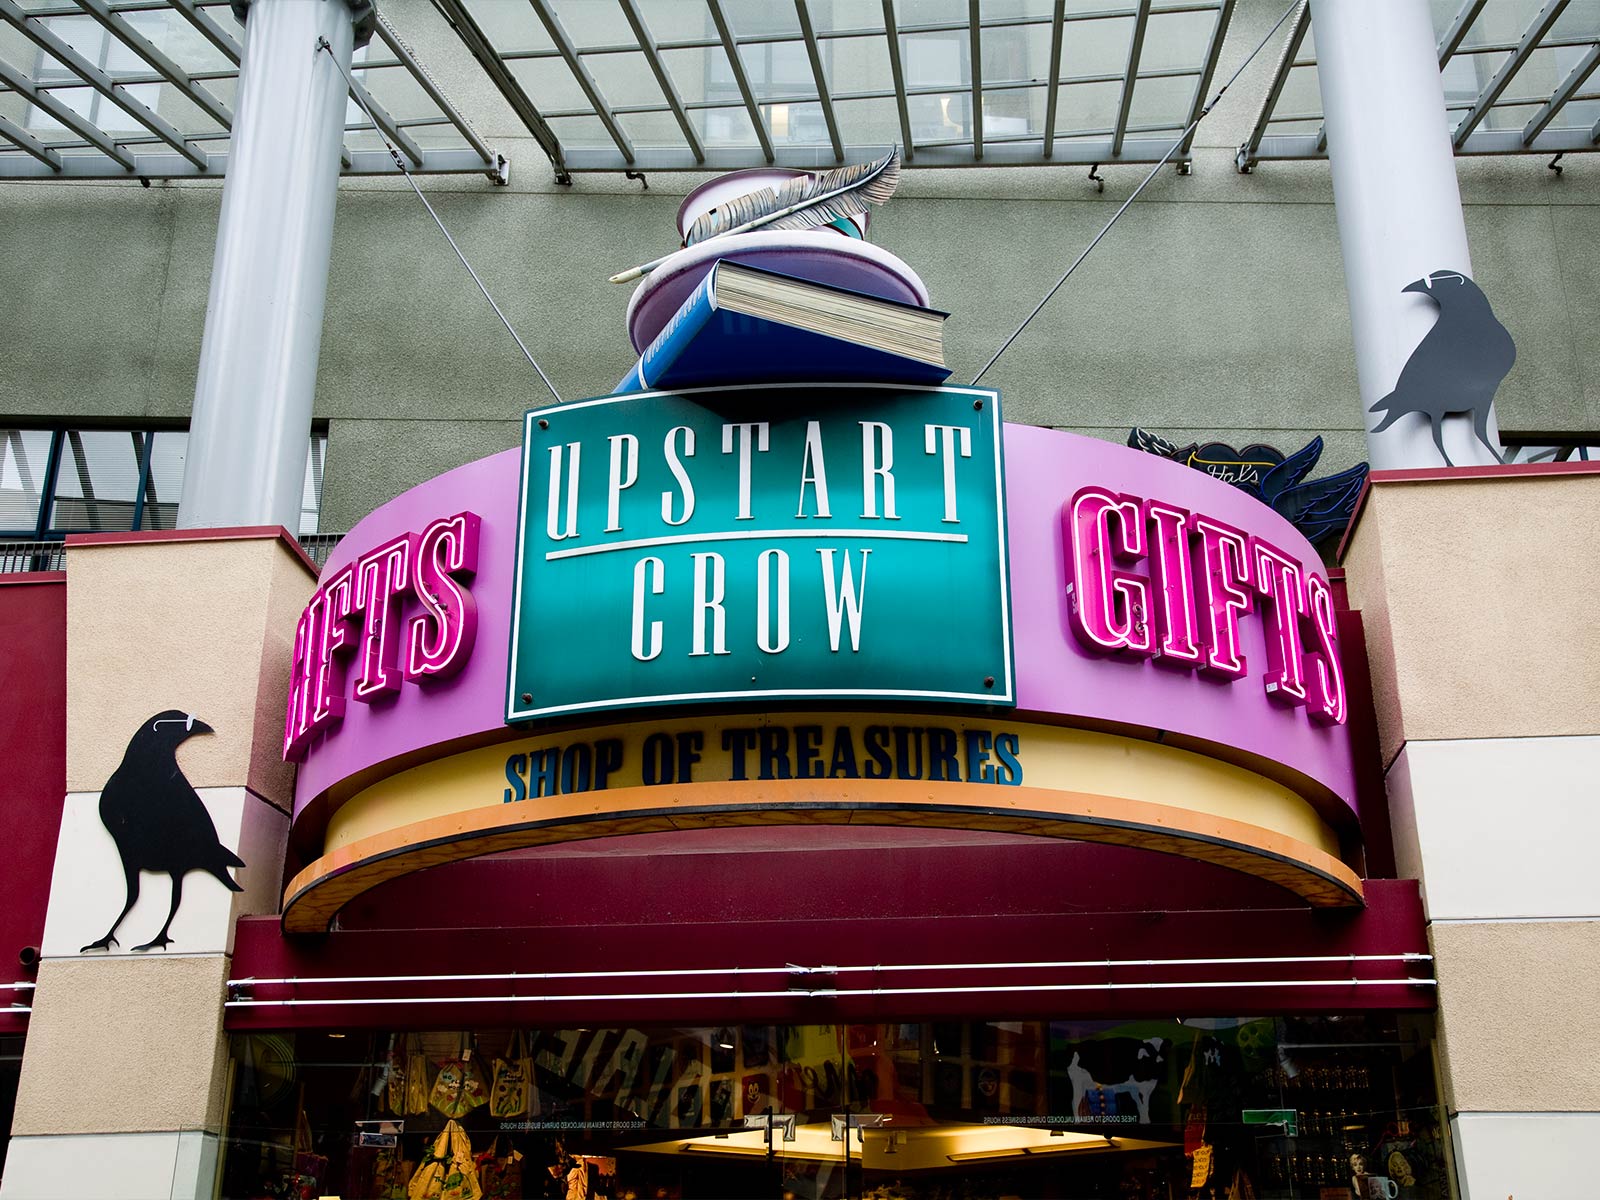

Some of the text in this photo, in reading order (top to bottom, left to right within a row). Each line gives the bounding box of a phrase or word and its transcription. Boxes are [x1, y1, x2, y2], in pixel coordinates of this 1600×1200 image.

[546, 420, 972, 540] UPSTART
[631, 548, 872, 661] CROW
[1061, 485, 1347, 724] GIFTS
[503, 724, 1025, 804] SHOP OF TREASURES
